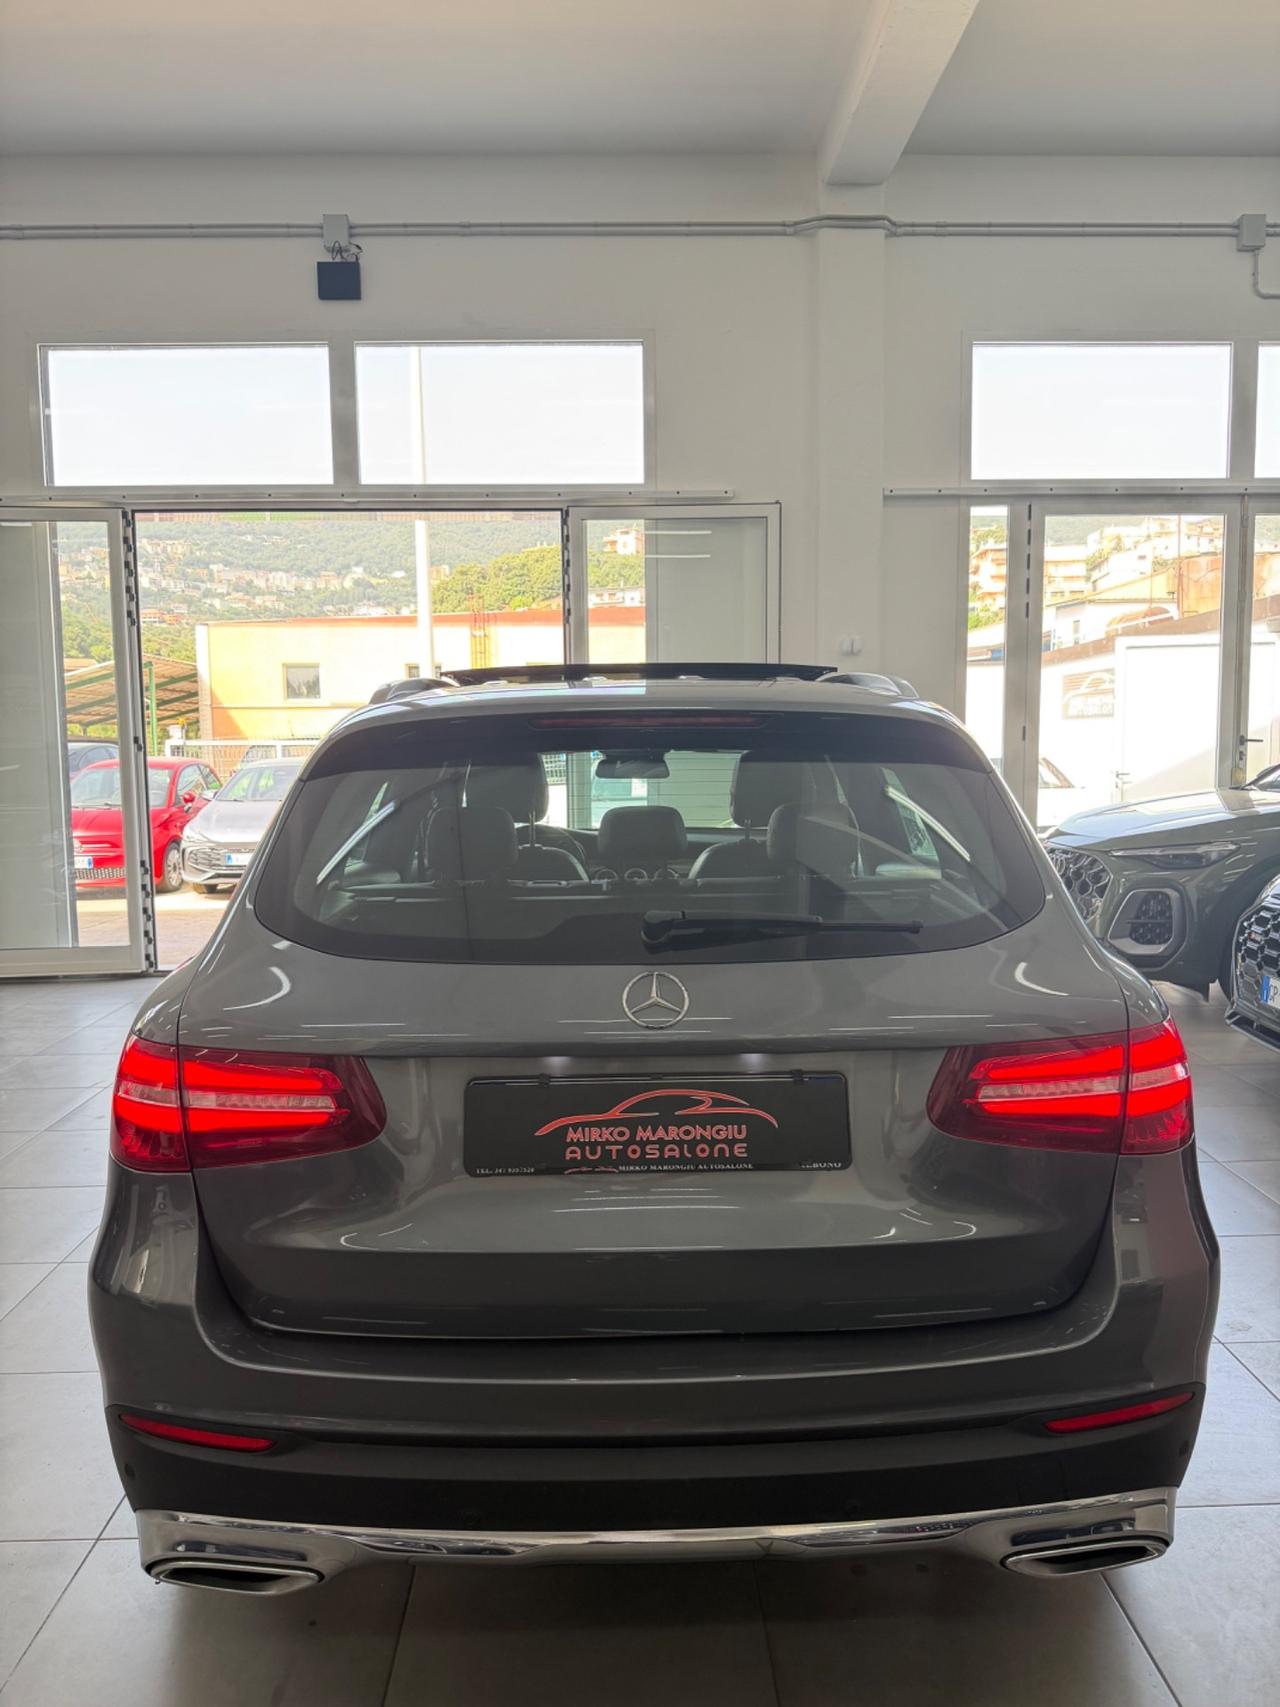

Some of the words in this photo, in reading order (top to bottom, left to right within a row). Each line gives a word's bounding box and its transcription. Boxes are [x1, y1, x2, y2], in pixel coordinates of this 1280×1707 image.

[566, 1126, 631, 1142] MIRKO
[636, 1125, 747, 1141] MARONGIU
[565, 1143, 748, 1160] AUTOSALONE
[650, 1163, 696, 1171] MARONGIU
